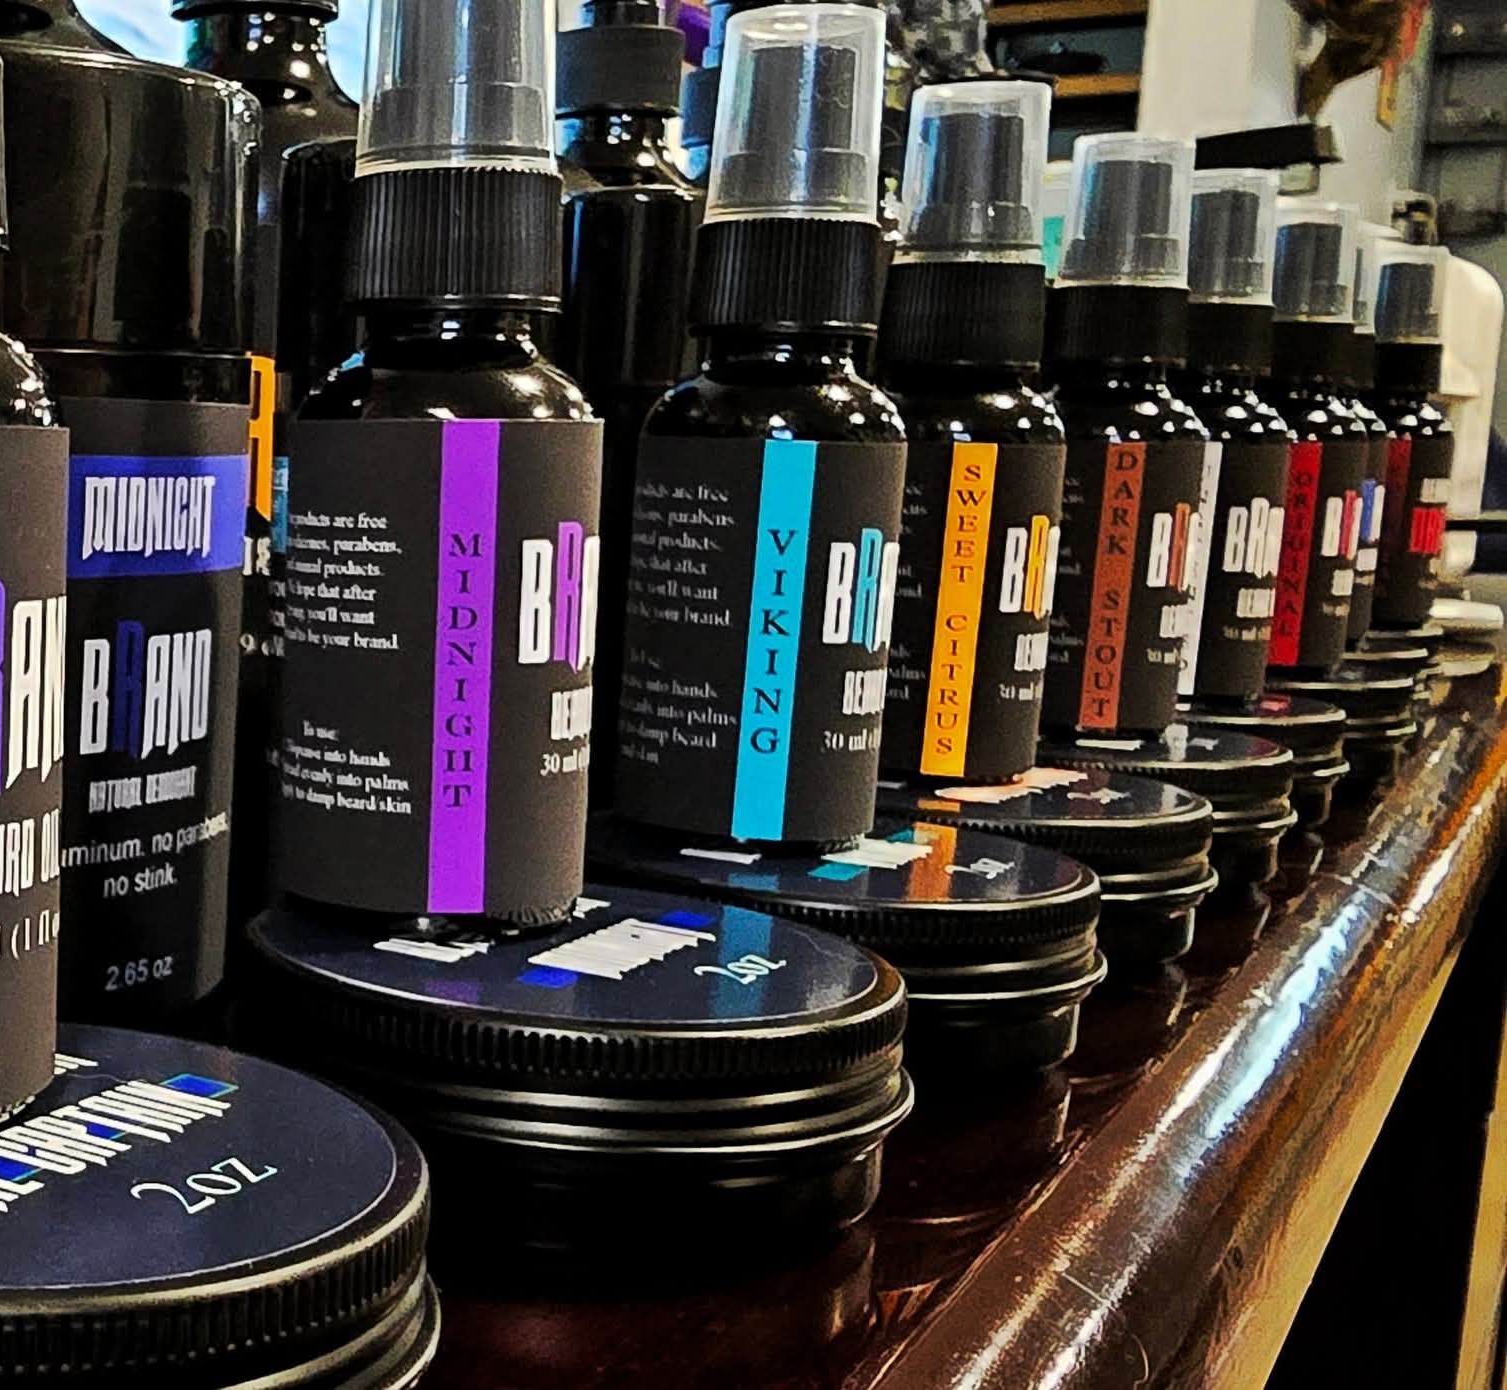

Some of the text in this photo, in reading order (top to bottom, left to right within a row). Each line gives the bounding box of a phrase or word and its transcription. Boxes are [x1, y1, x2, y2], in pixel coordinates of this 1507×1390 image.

[82, 475, 216, 561] MIDNIGHT
[935, 463, 988, 755] SWEET CITRUS
[1091, 450, 1139, 718] DARK STOUT
[79, 619, 212, 763] BRAND
[442, 532, 484, 808] MIDNIGHT
[750, 529, 799, 755] VIKING
[103, 861, 178, 899] no stink.
[151, 831, 175, 855] no
[152, 955, 174, 981] oz
[129, 1156, 279, 1215] 2oz
